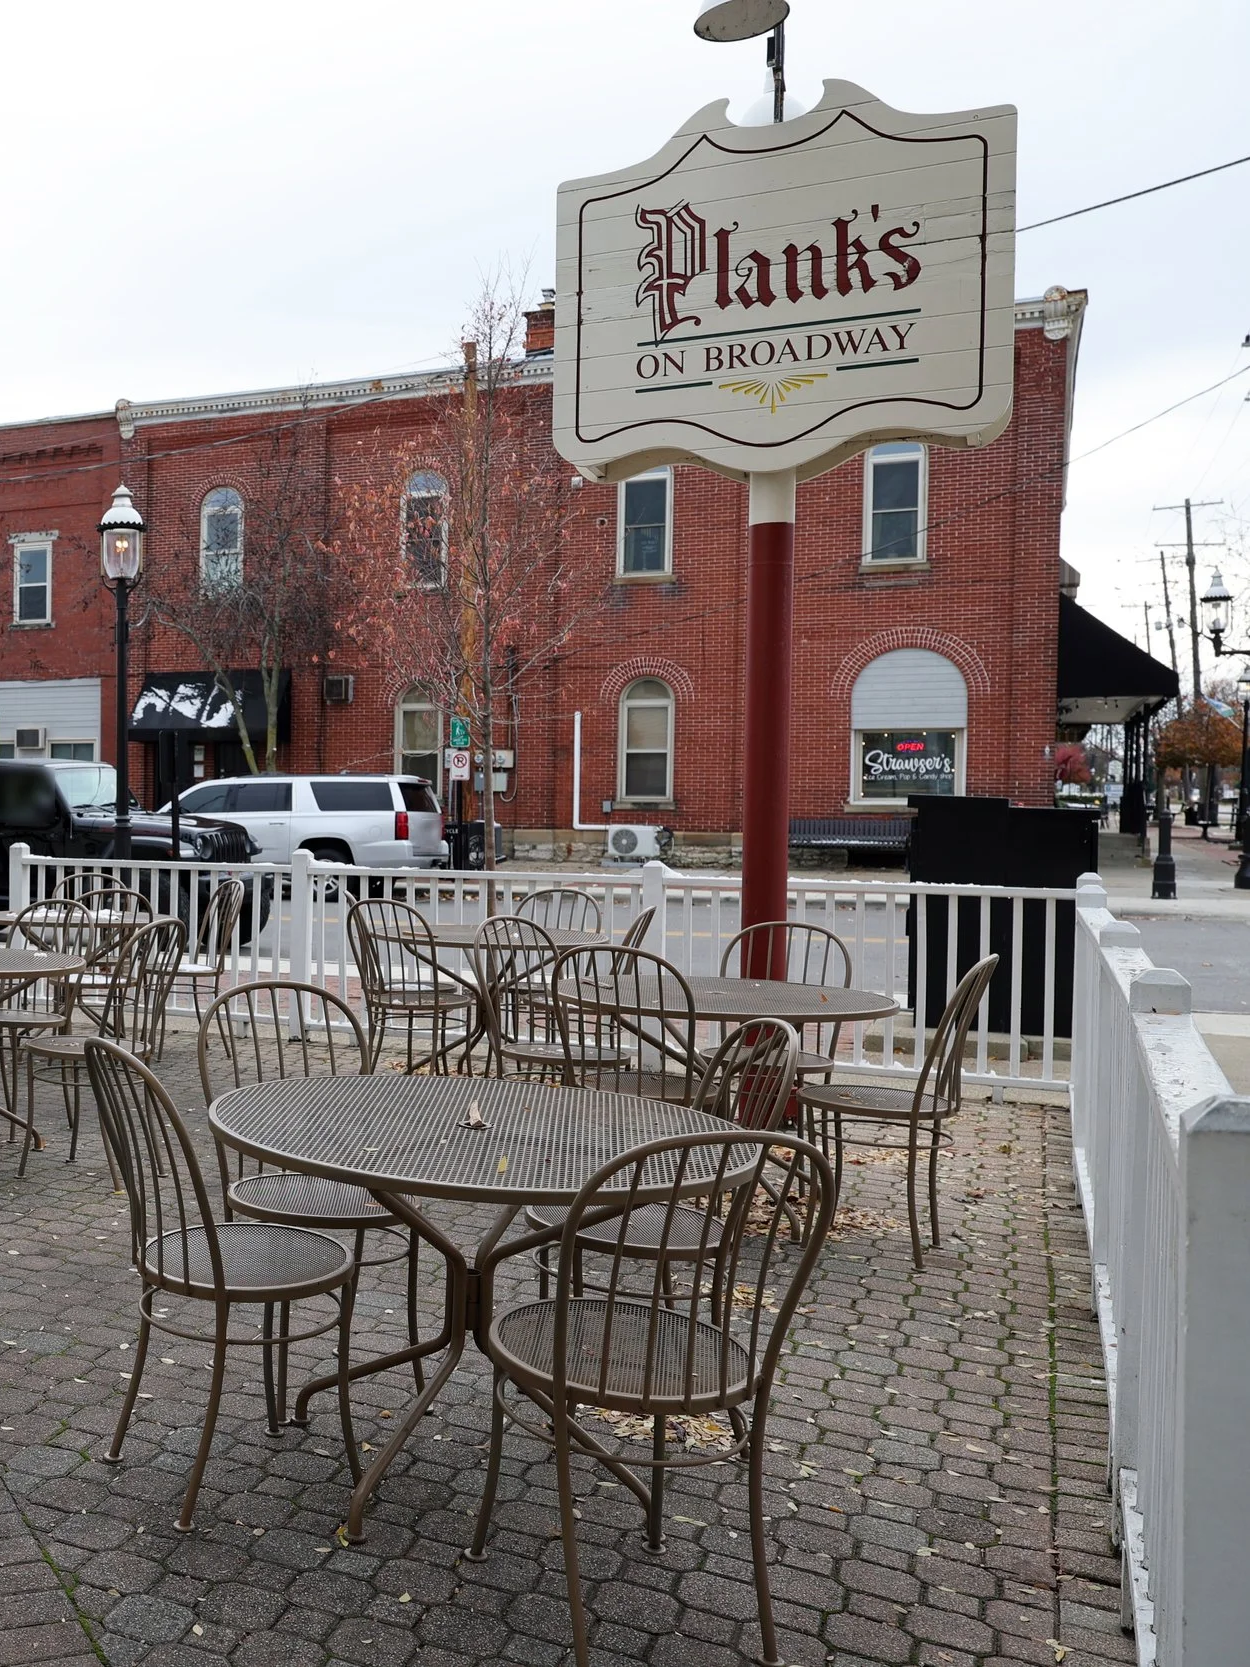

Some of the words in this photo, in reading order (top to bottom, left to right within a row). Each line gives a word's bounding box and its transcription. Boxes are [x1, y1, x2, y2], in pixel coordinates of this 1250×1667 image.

[635, 199, 922, 347] Plank's
[636, 350, 686, 380] ON
[704, 322, 916, 373] BROADWAY
[865, 750, 952, 774] Strawser's
[896, 742, 925, 751] OPEN
